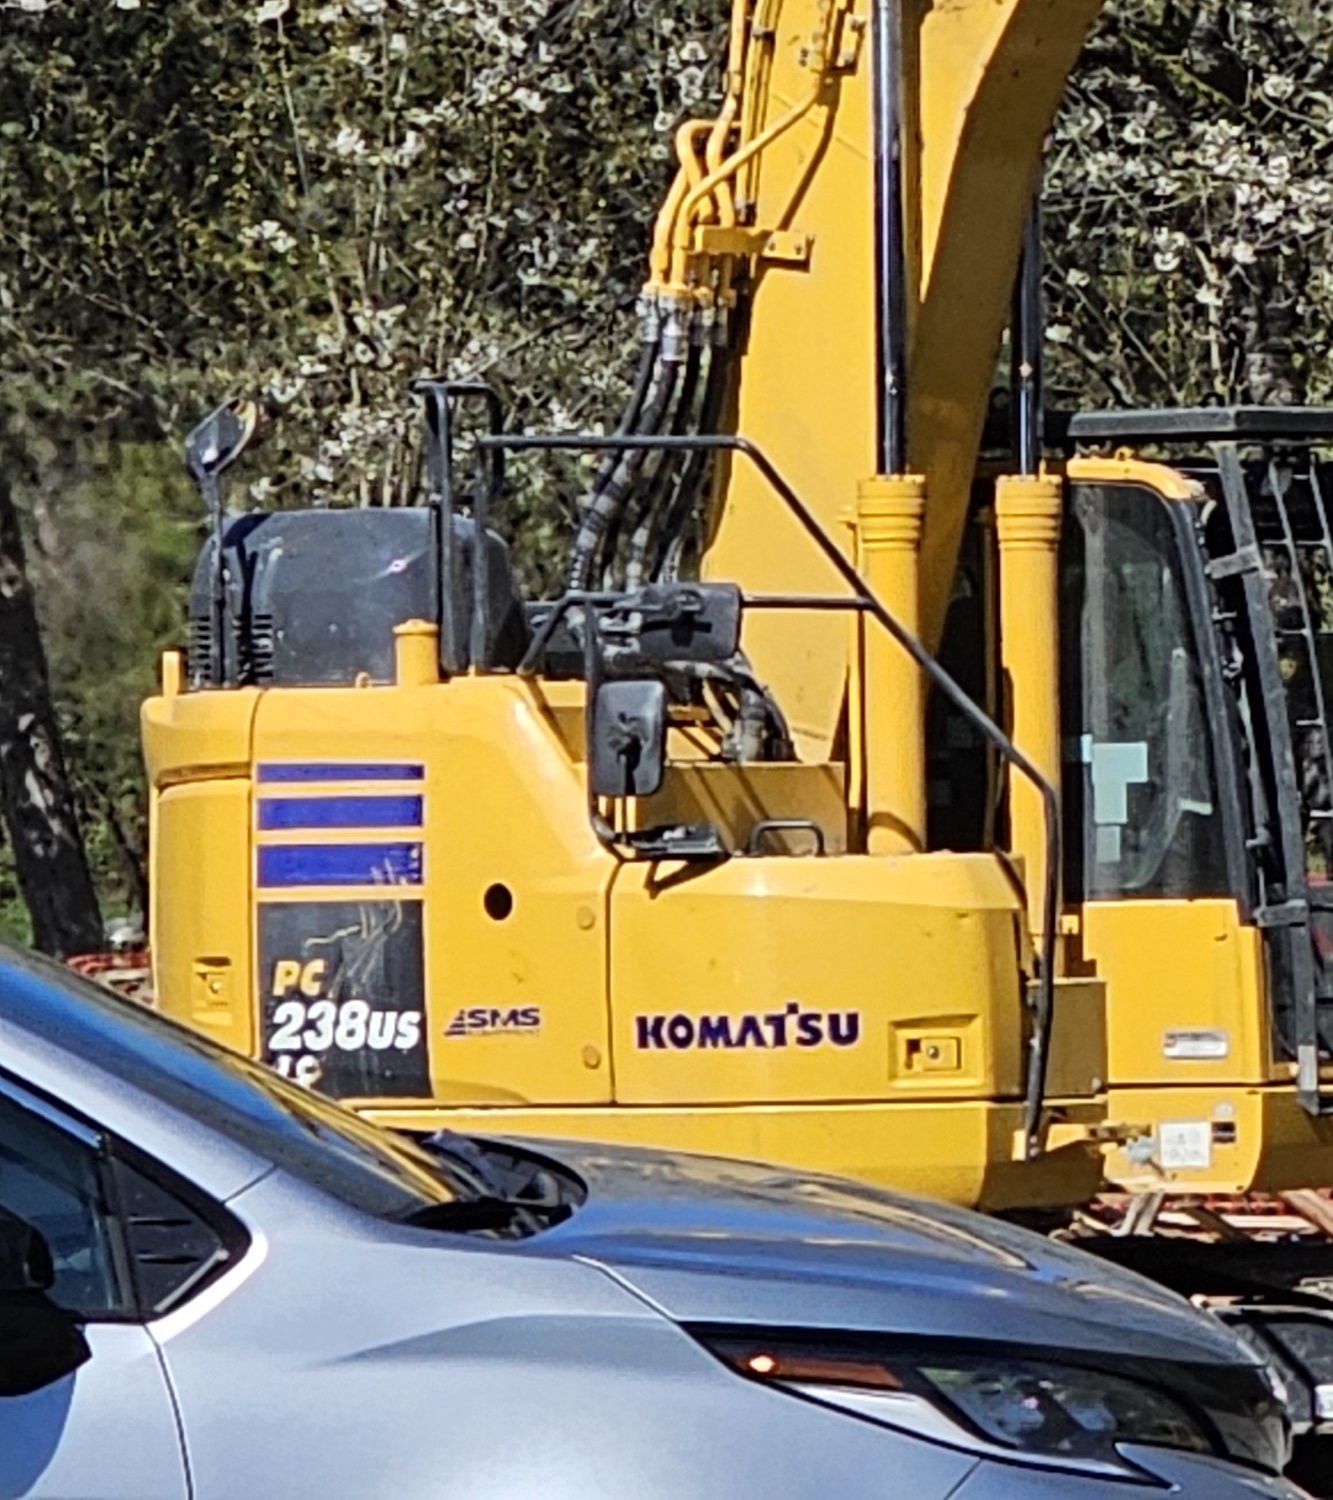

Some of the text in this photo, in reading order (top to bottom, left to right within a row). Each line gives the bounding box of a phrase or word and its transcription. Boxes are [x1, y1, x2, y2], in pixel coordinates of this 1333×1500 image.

[272, 959, 327, 996] PC
[467, 1007, 541, 1028] SMS
[636, 1003, 860, 1049] KOMATSU
